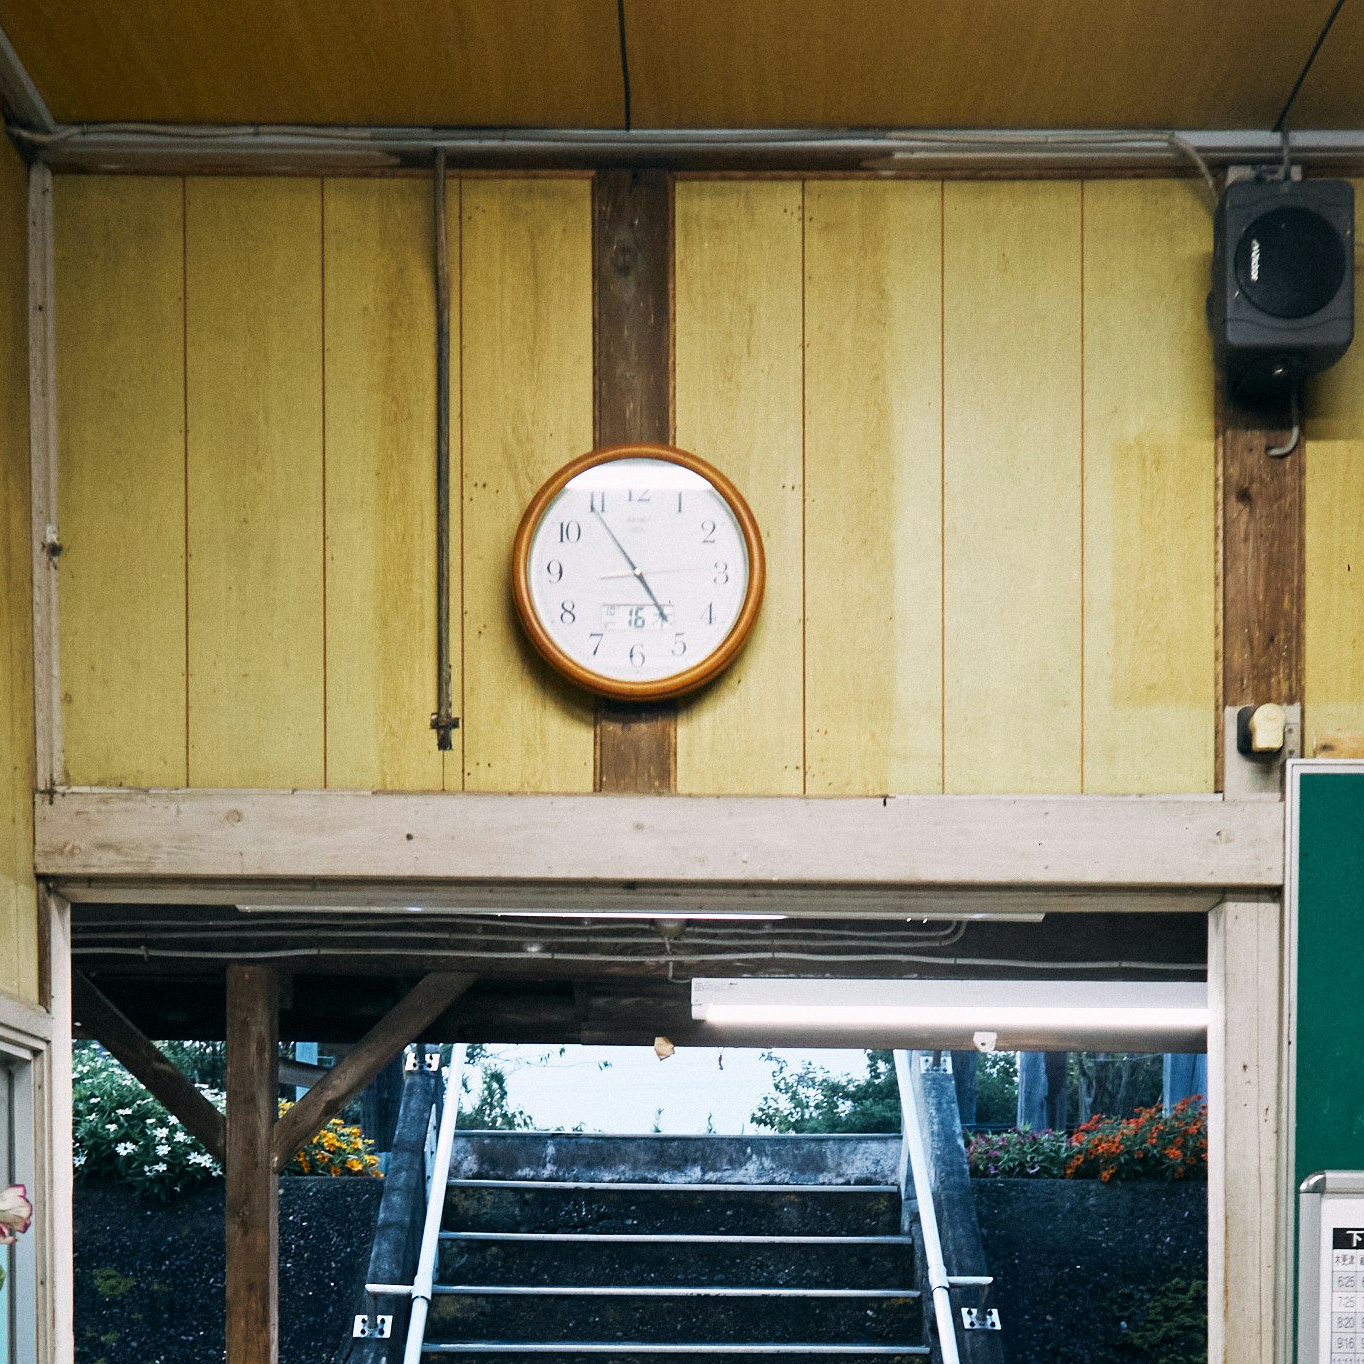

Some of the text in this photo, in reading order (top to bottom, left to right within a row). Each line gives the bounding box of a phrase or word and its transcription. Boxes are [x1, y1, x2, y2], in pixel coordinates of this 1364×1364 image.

[590, 491, 605, 513] 11
[677, 491, 683, 513] 1
[559, 519, 582, 543] 10
[701, 519, 716, 544] 2
[546, 559, 563, 584] 9
[713, 559, 729, 585] 3
[560, 599, 576, 624] 8
[628, 606, 645, 629] 16
[700, 601, 716, 625] 4
[589, 632, 603, 656] 7
[629, 643, 645, 668] 6
[671, 631, 687, 656] 5
